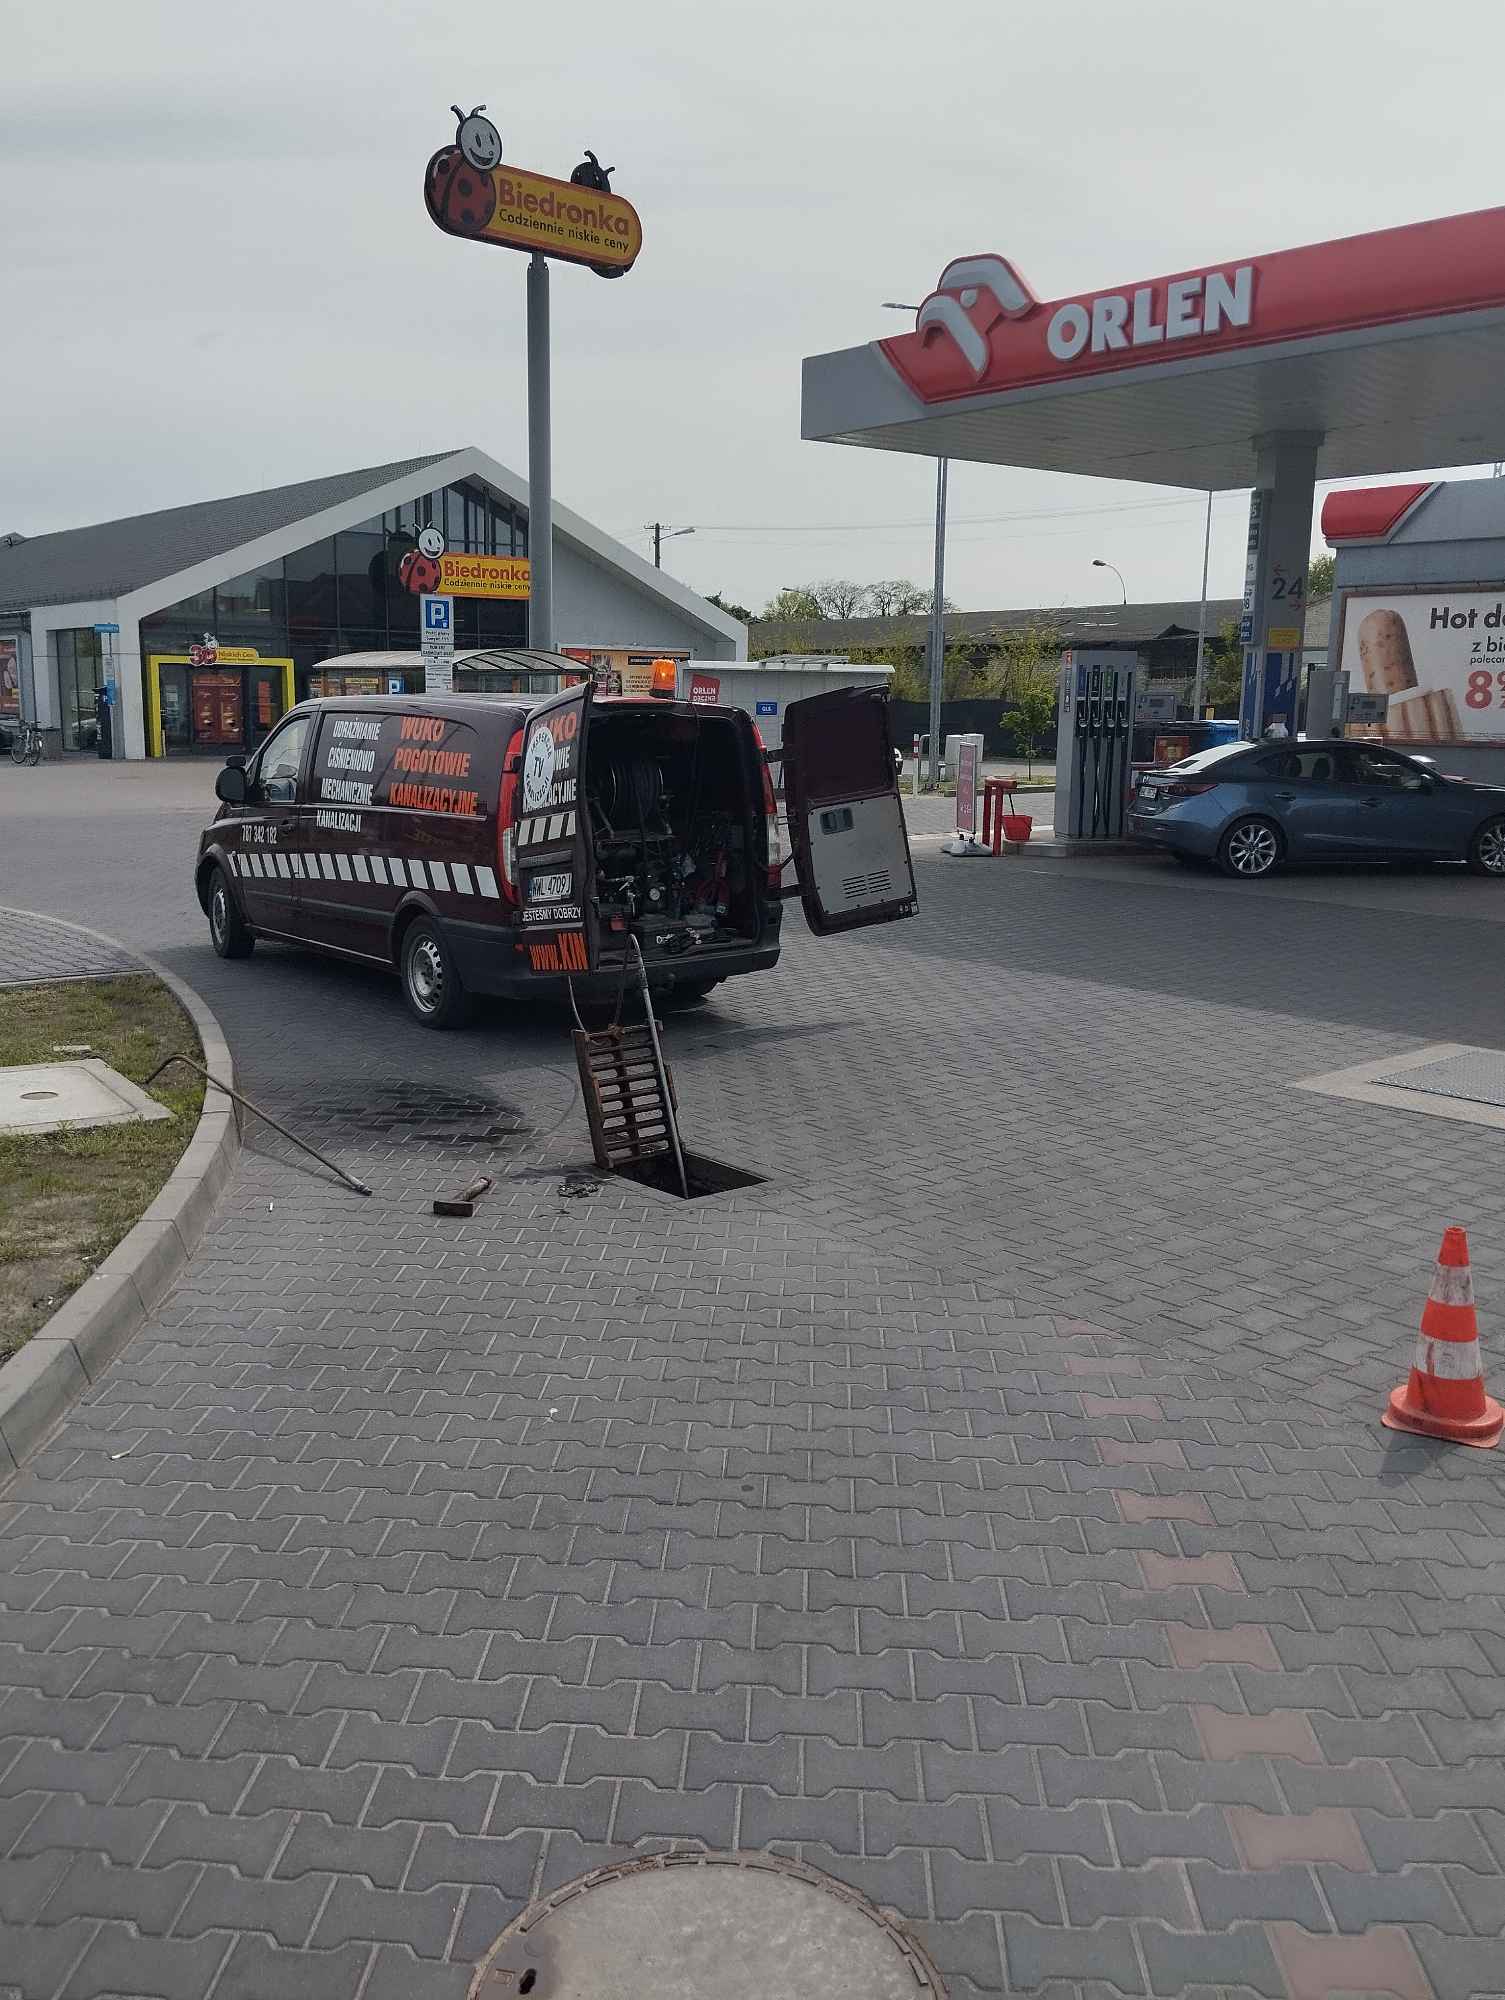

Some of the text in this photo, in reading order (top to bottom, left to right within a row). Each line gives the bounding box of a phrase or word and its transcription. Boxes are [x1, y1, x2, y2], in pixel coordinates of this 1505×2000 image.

[499, 178, 630, 236] Biedronka
[499, 208, 630, 253] Codziennie niskie ceny
[1047, 266, 1254, 361] ORLEN
[444, 579, 488, 589] Codziennie
[490, 581, 512, 590] niskie
[1271, 577, 1303, 600] 24
[431, 602, 446, 626] P
[1430, 603, 1505, 629] Hot d
[1472, 636, 1505, 653] z bi
[692, 687, 716, 695] ORLEN
[401, 716, 445, 742] WUKO
[394, 748, 472, 778] POGOTOWIE
[534, 756, 544, 778] TV
[389, 782, 479, 816] KANALIZACYJNE
[316, 809, 362, 833] KANALIZACJI
[553, 906, 581, 920] DOBRZY
